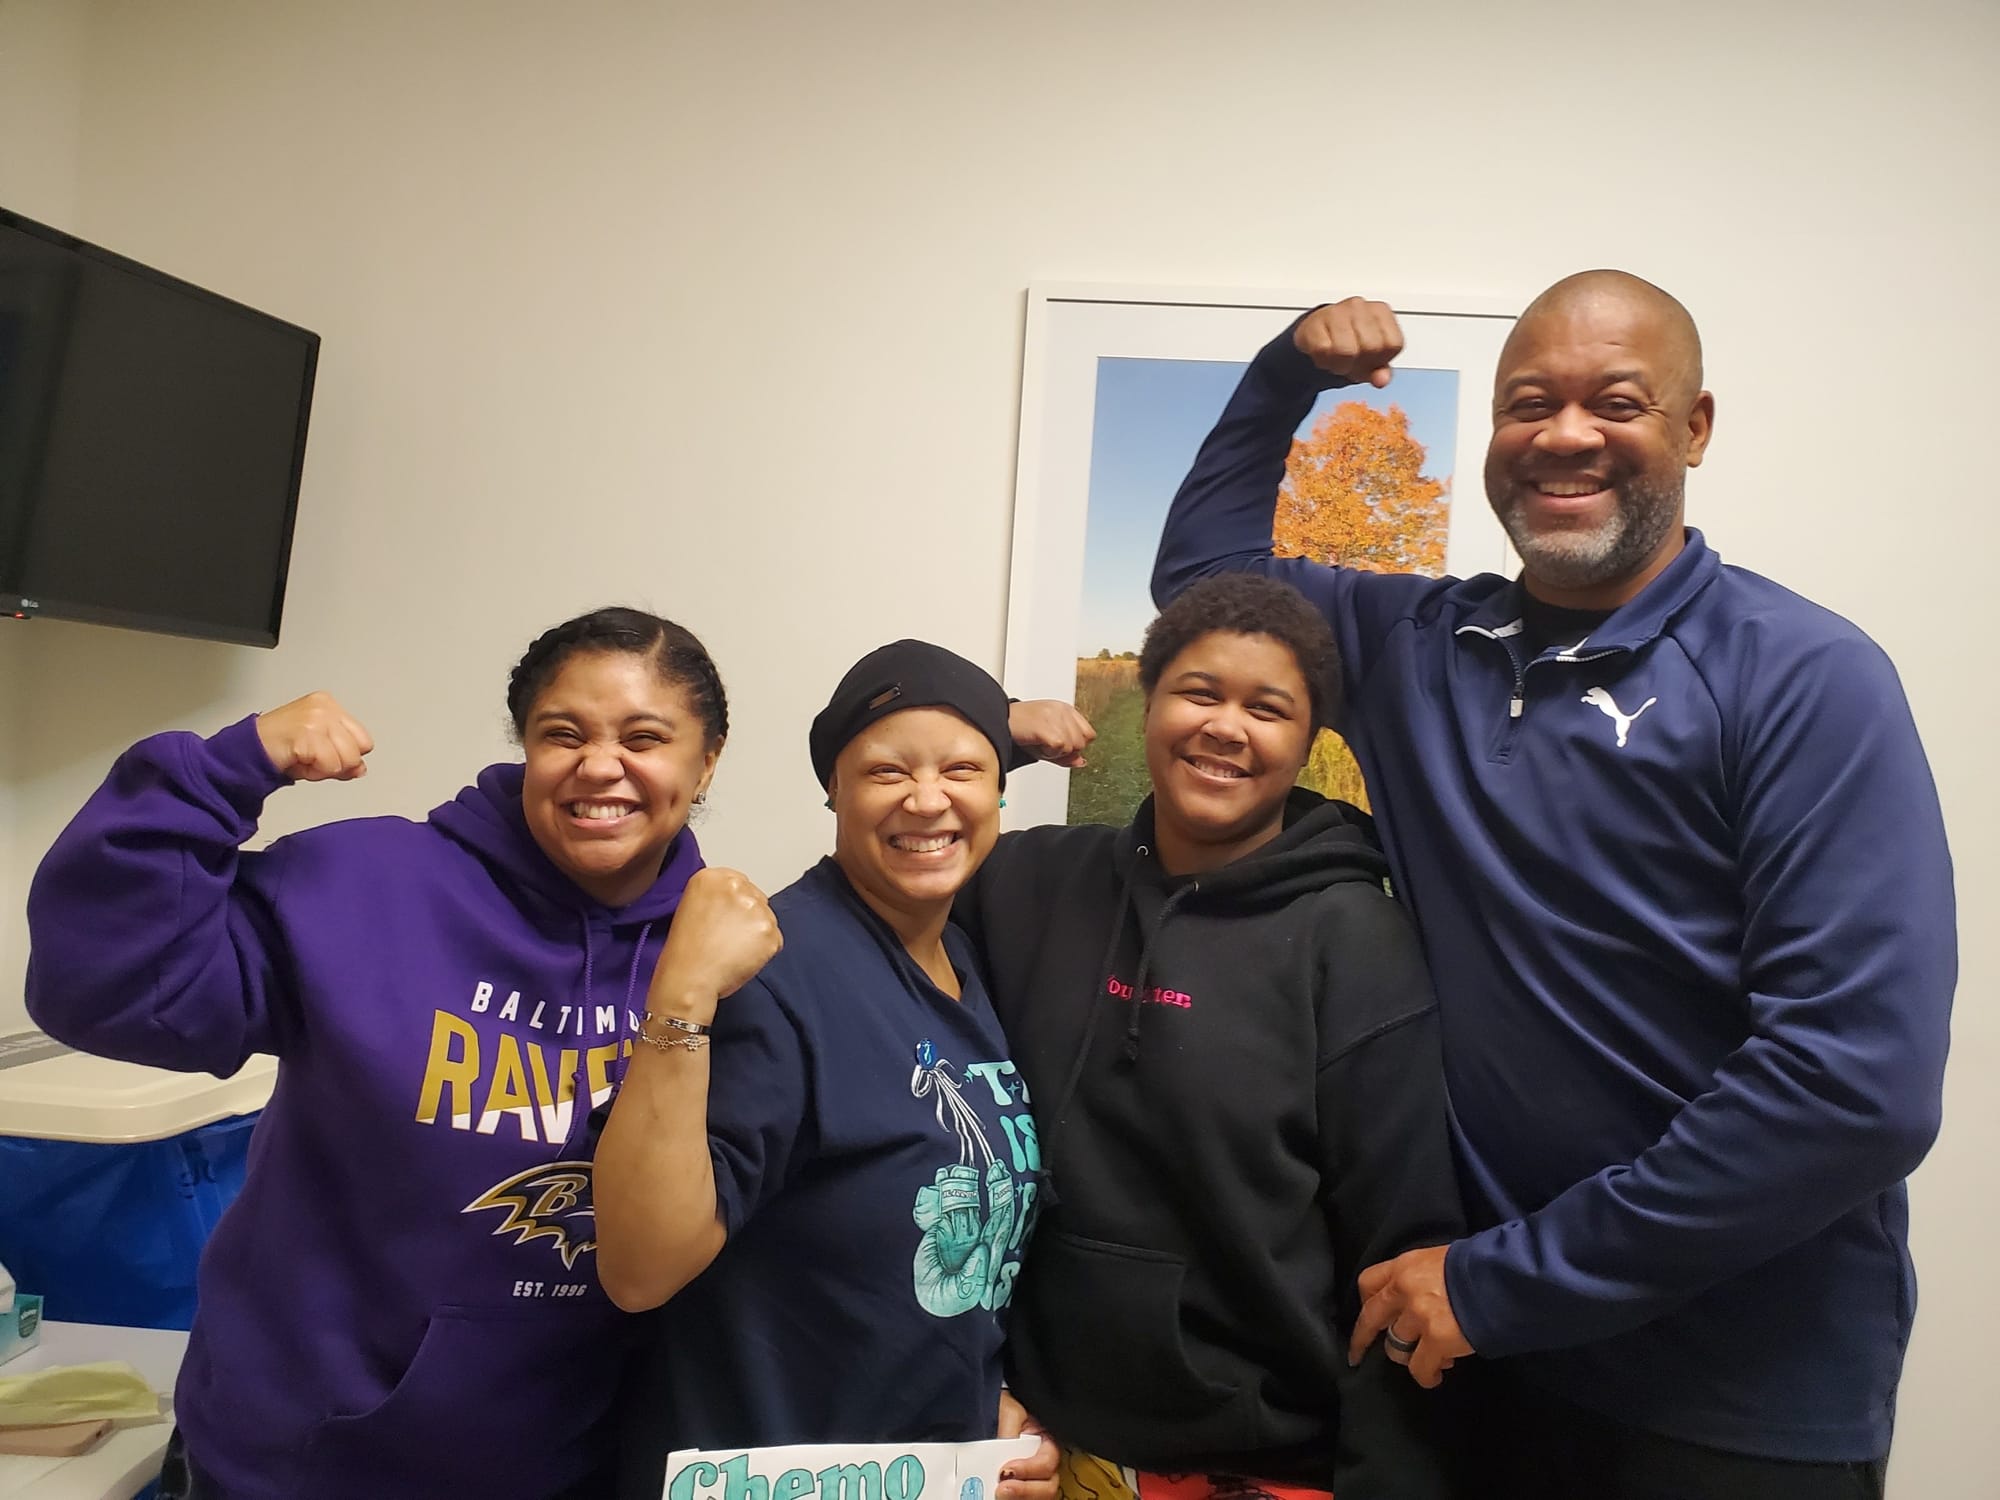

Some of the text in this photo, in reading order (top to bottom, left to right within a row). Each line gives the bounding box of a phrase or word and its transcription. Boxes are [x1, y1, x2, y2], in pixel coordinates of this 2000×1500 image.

[512, 1280, 588, 1297] EST. 1996
[669, 1453, 925, 1500] Chemo
